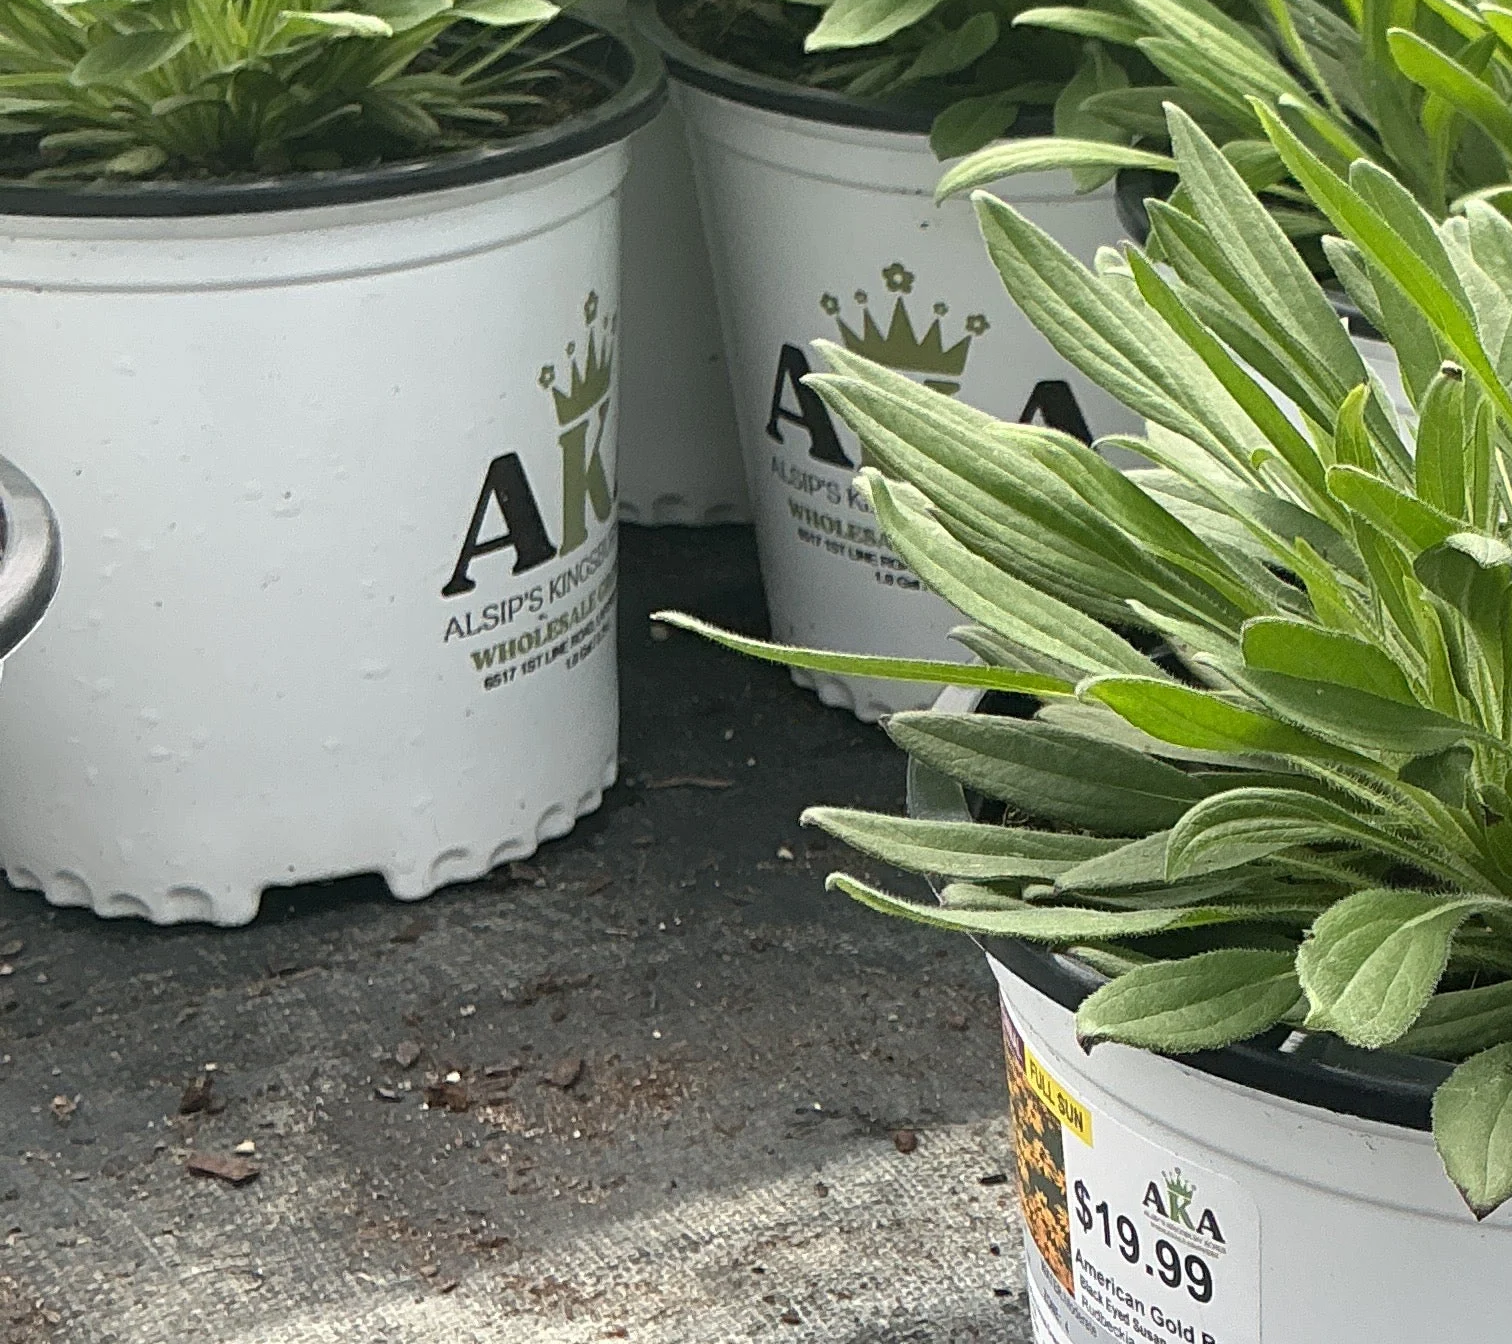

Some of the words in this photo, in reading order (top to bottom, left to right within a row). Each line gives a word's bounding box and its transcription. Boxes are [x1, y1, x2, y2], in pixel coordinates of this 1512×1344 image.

[771, 456, 842, 505] ALSIP'S
[443, 585, 543, 643] ALSIP'S
[470, 589, 598, 671] WHOLESALE
[1030, 1058, 1055, 1106] FULL
[1057, 1091, 1083, 1133] SUN
[1074, 1179, 1213, 1304] $19.99
[1142, 1181, 1226, 1244] AKA
[1075, 1248, 1146, 1316] American
[1150, 1306, 1196, 1344] Gold
[1080, 1274, 1104, 1307] Black
[1105, 1297, 1131, 1327] Eyed
